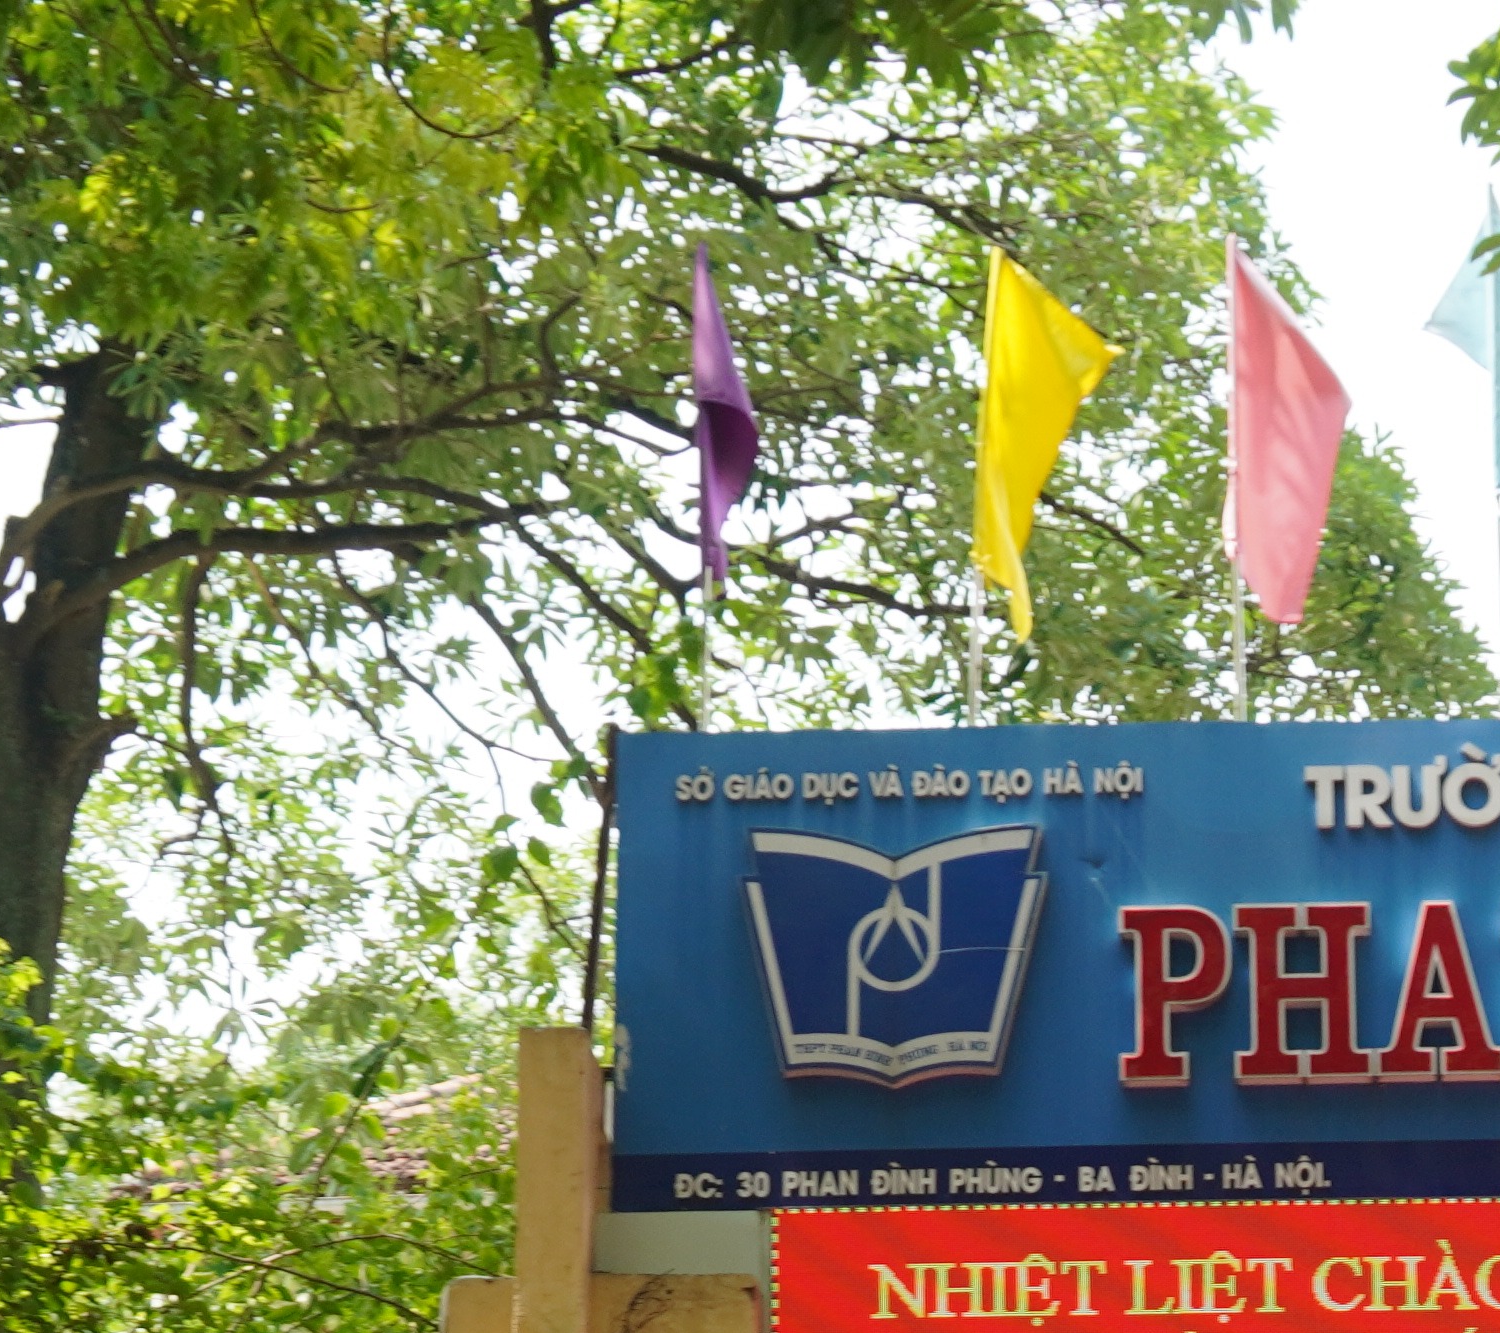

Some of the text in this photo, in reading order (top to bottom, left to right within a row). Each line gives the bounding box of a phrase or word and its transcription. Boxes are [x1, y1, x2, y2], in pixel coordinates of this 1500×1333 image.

[675, 760, 1144, 806] SỞ GIÁO DỤC VÀ ĐÀO TẠO HÀ NỘI
[674, 1171, 723, 1199] ĐC:
[736, 1170, 771, 1199] 30
[782, 1169, 860, 1199] PHAN
[871, 1162, 938, 1197] ĐÌNH
[948, 1158, 1044, 1196] PHÙNG
[1077, 1165, 1116, 1193] BA
[1129, 1157, 1195, 1192] ĐÌNH
[1221, 1155, 1263, 1191] HÀ
[867, 1253, 1109, 1328] NHIỆT
[1124, 1250, 1294, 1325] LIỆT
